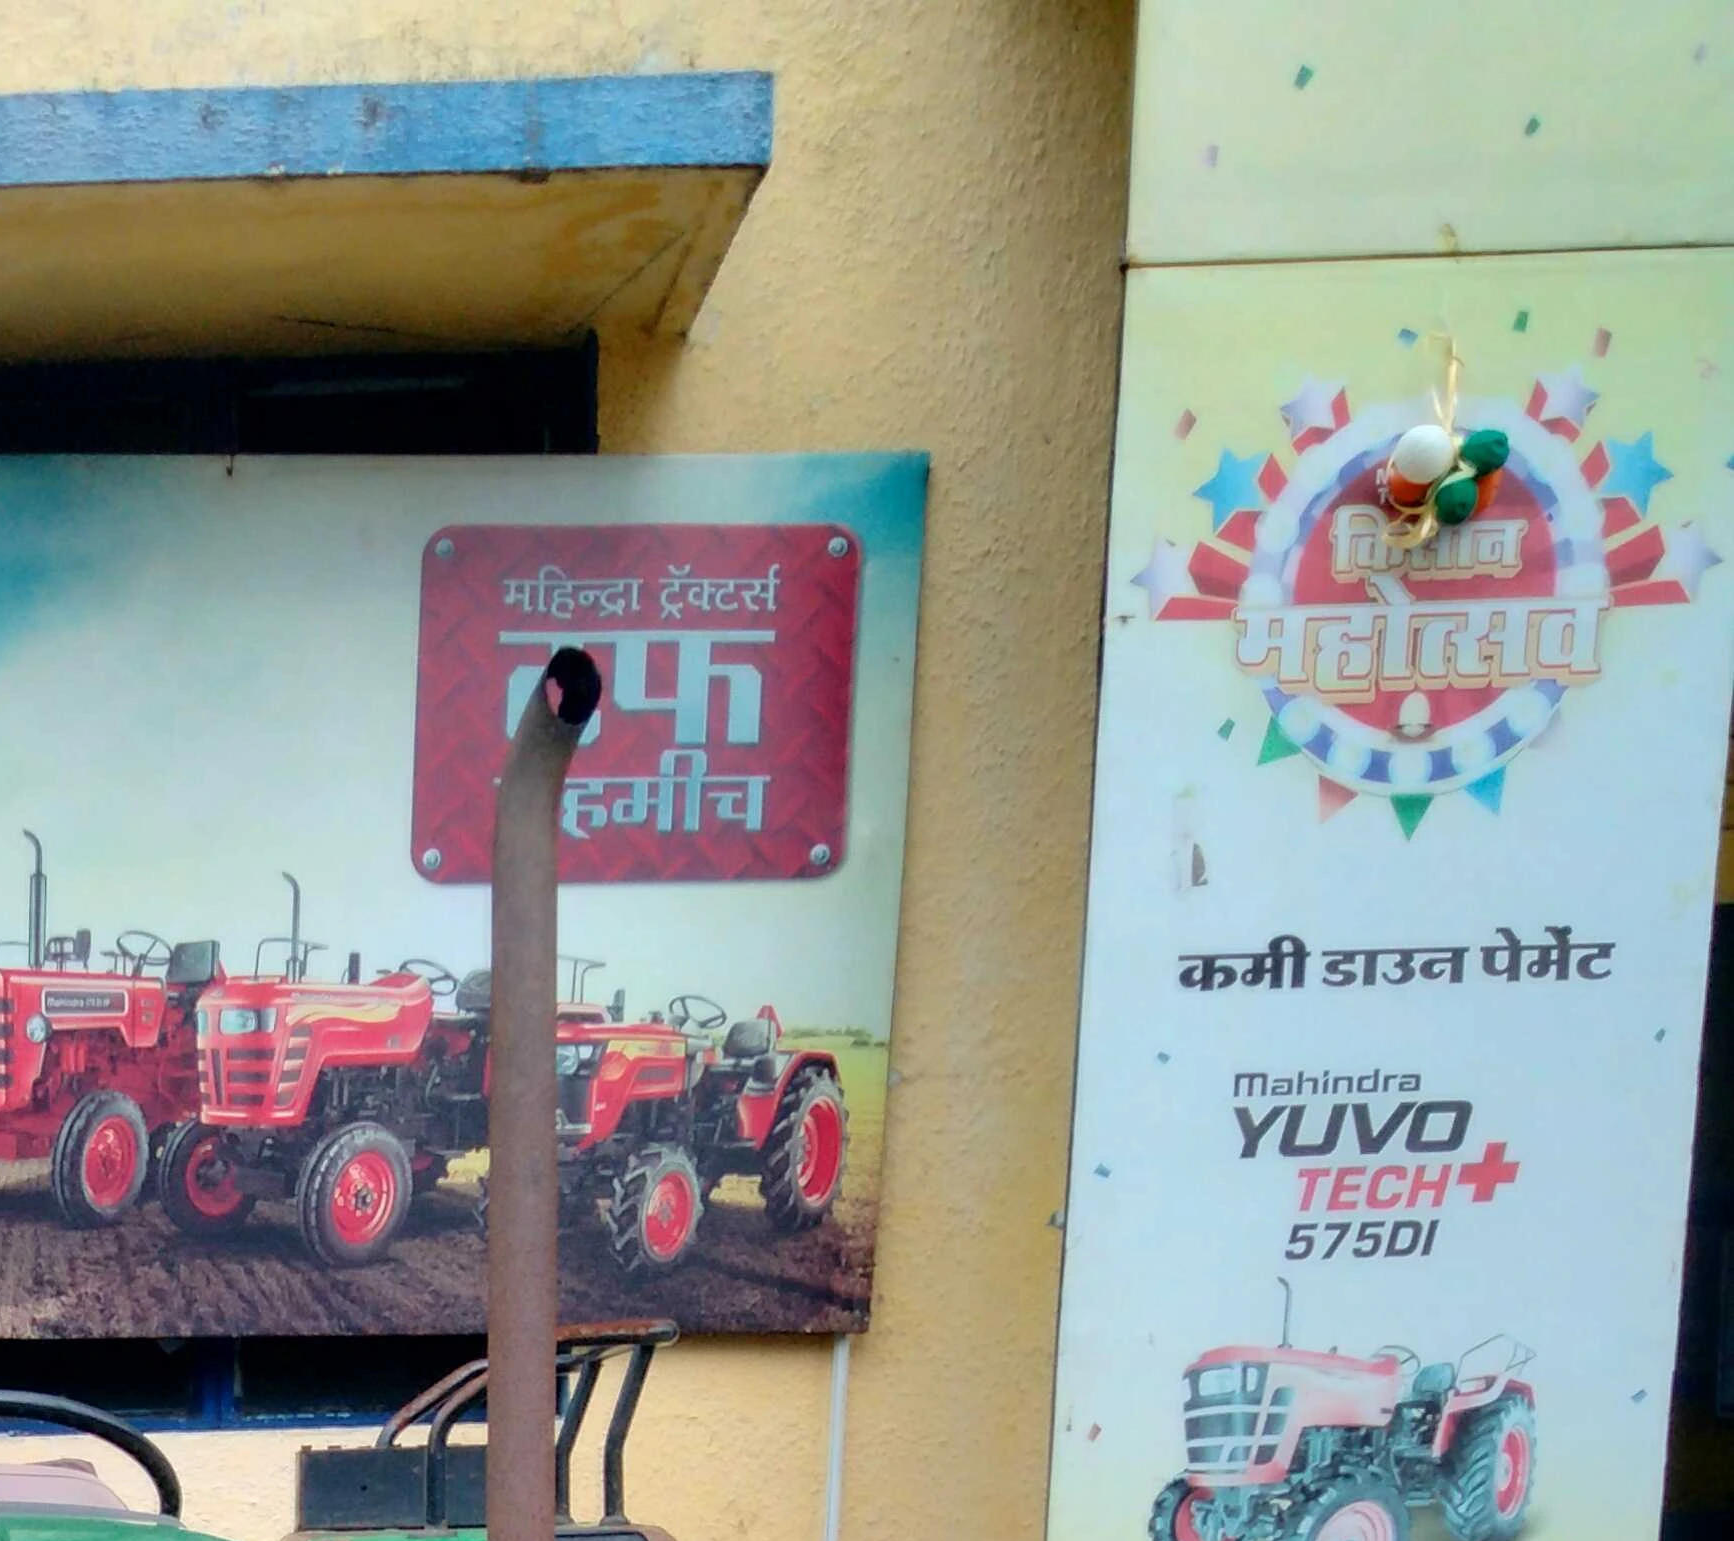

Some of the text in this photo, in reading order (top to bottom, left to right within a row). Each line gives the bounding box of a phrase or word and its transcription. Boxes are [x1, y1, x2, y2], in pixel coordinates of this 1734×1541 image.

[503, 564, 781, 619] महिन्द्रा ट्रॅक्टर्स
[493, 749, 771, 839] हमीच
[1178, 934, 1310, 992] कमी
[1322, 947, 1470, 988] डाउन
[1233, 1069, 1422, 1097] Mahindra
[1233, 1099, 1473, 1159] YUVO
[1284, 1219, 1440, 1260] 575DI
